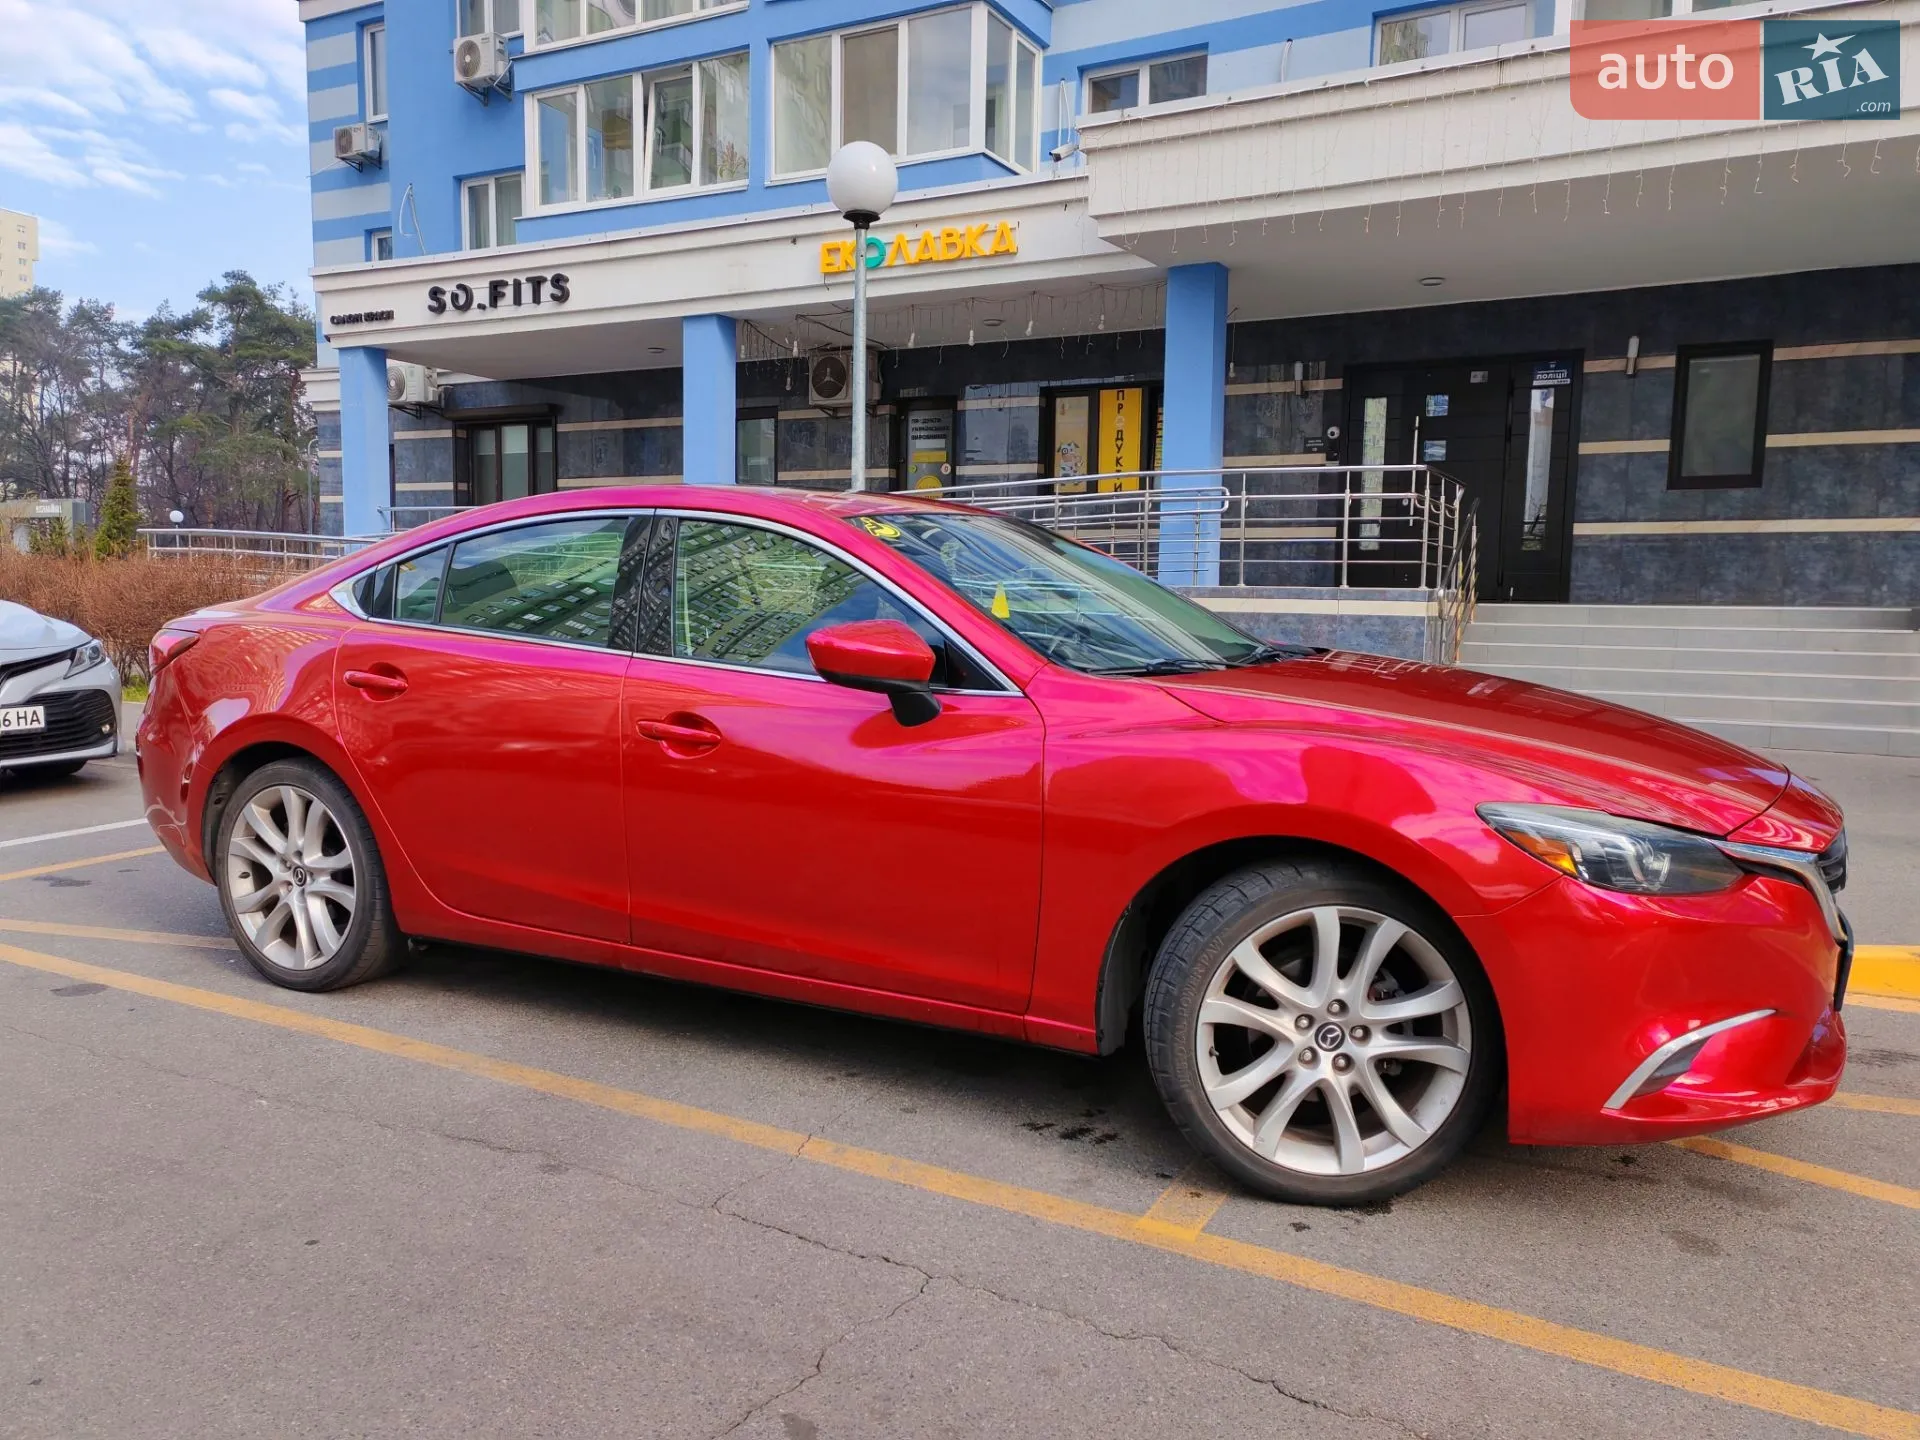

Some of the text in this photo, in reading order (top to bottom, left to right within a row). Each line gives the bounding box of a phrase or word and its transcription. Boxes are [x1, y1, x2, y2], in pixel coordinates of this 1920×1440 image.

[820, 220, 1018, 274] ЕКОЛАВКА
[427, 273, 570, 315] SO.FITS
[16, 710, 41, 727] HA
